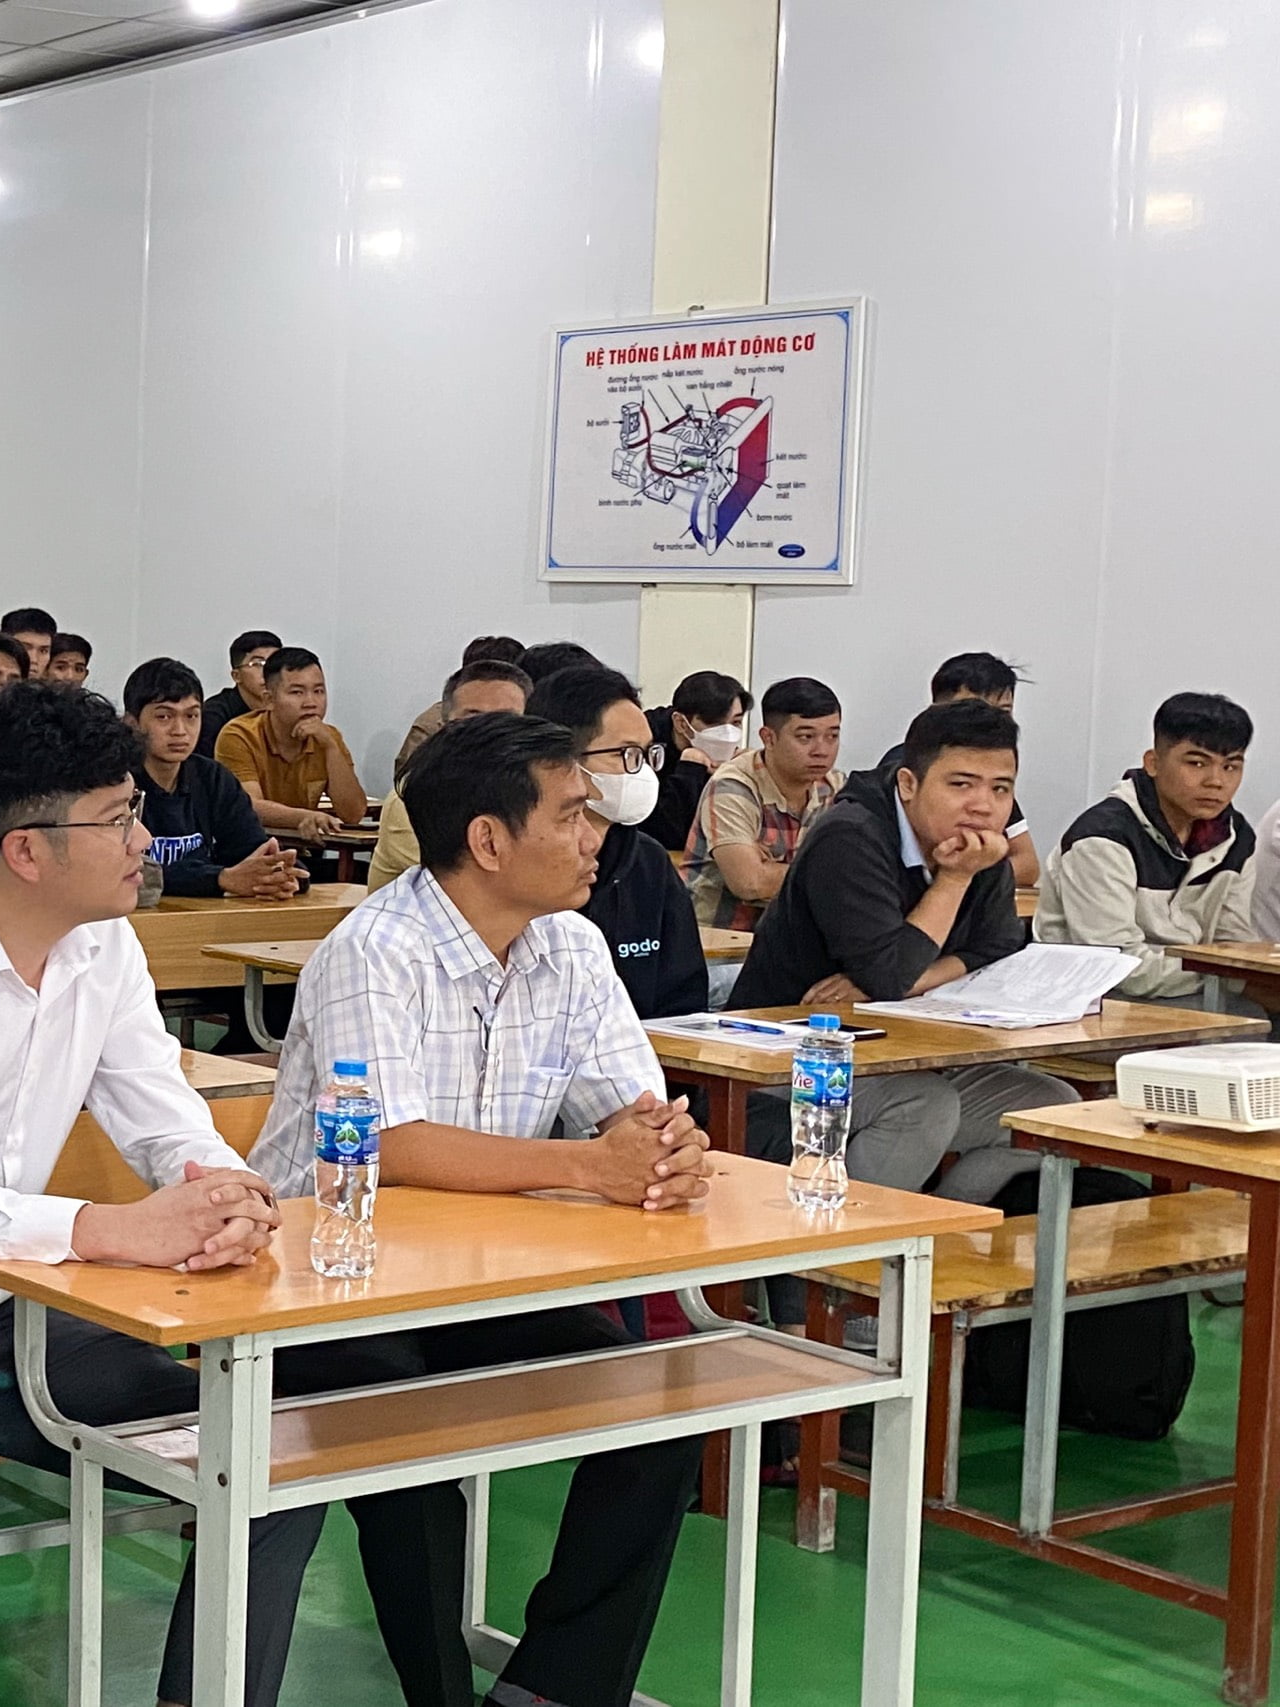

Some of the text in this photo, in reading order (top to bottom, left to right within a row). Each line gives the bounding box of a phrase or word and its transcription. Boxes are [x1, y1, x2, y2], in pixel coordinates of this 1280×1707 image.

[586, 332, 816, 369] HỆ THỐNG LÀM MÁT ĐỘNG CƠ
[618, 938, 660, 958] godo
